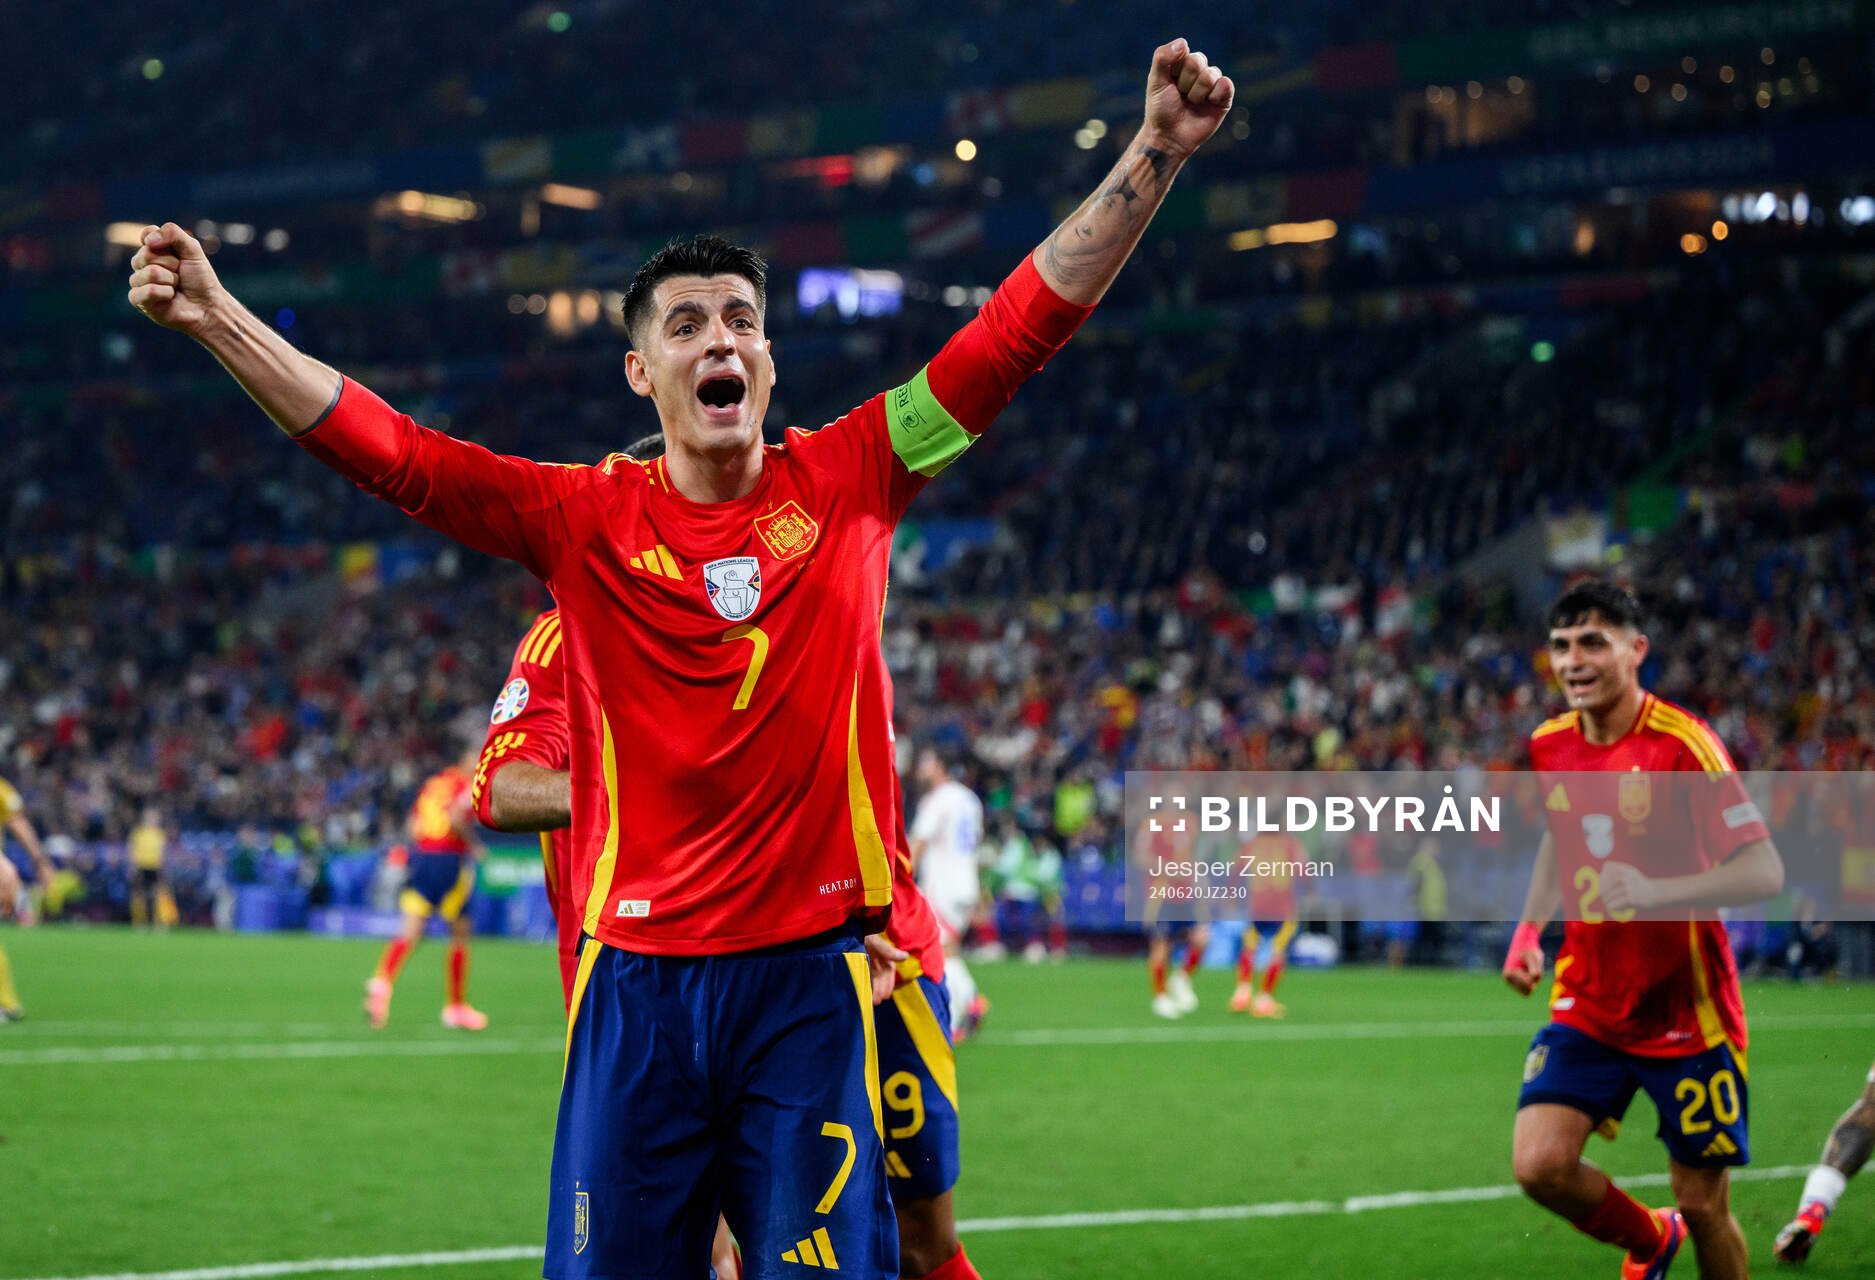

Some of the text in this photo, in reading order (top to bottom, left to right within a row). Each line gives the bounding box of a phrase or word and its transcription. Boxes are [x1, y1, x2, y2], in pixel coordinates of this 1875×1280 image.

[721, 623, 770, 710] 7
[1574, 866, 1637, 924] 2
[1675, 1069, 1740, 1135] 20
[815, 1121, 857, 1215] 7
